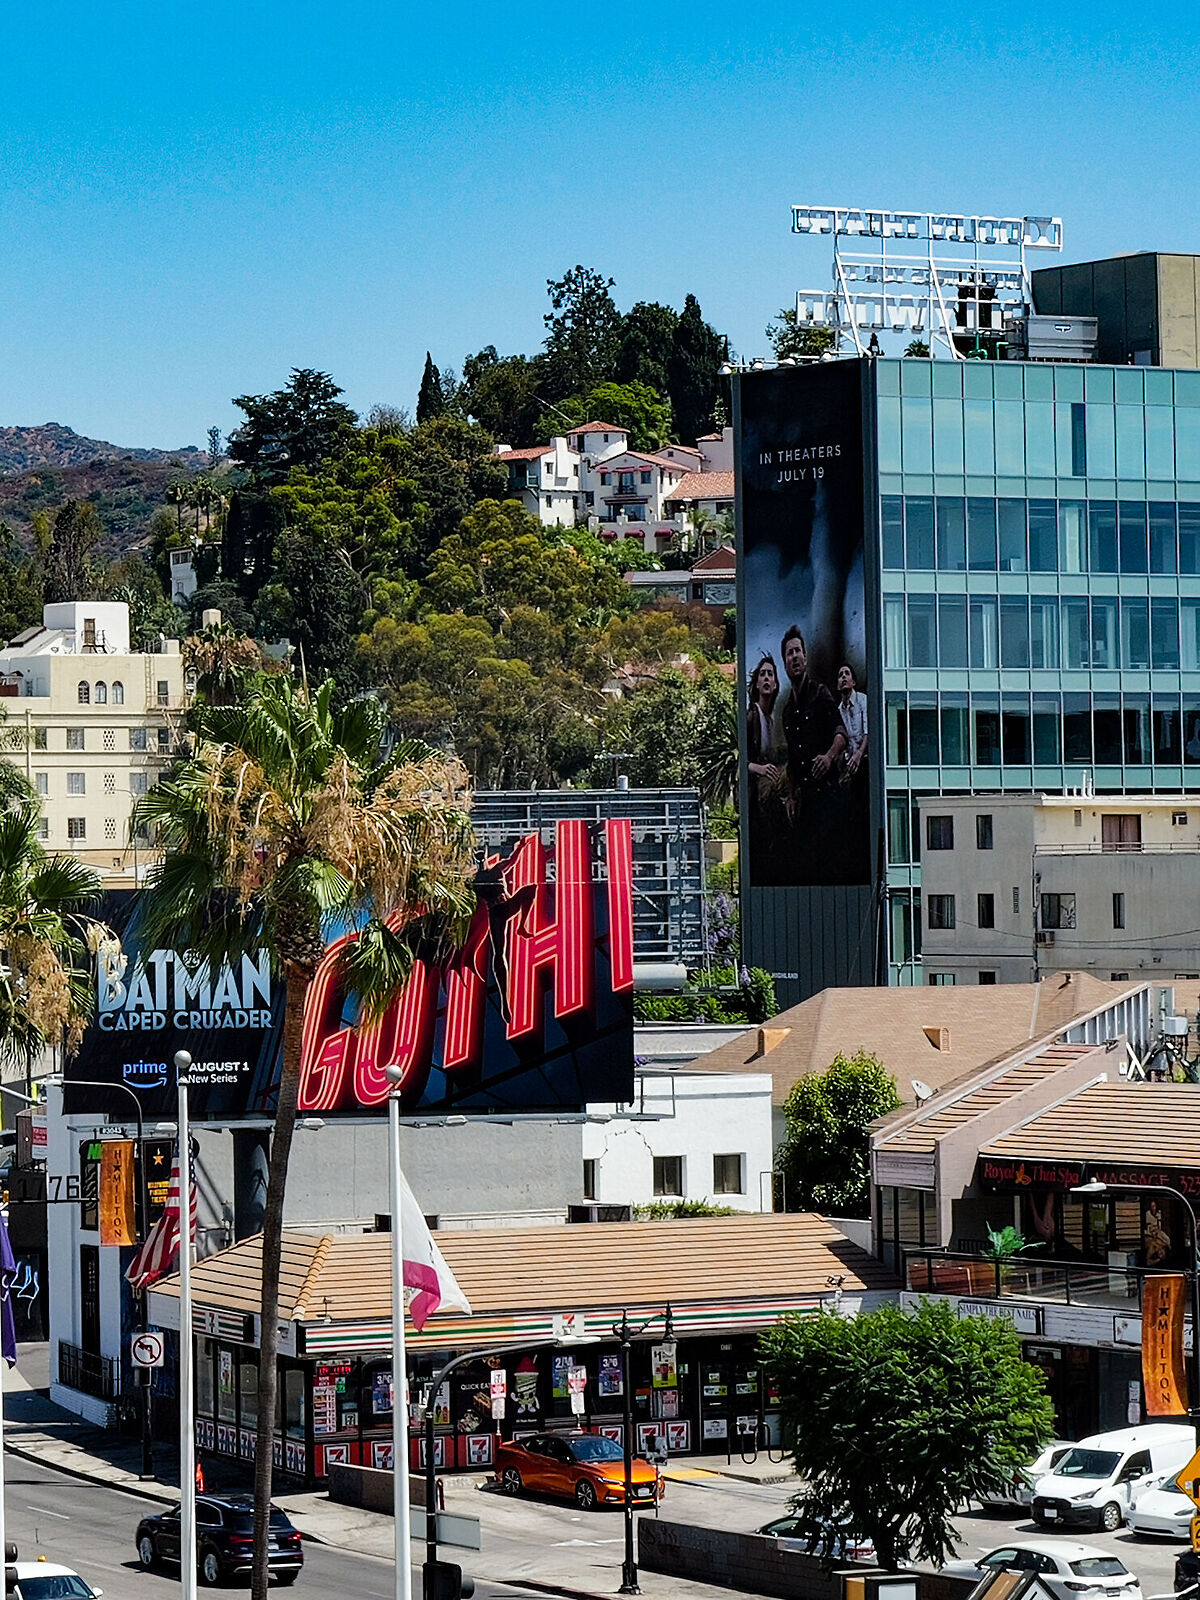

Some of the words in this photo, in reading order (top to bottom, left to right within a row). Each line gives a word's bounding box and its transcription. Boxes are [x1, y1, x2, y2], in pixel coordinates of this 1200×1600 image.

[759, 452, 772, 465] IN
[777, 444, 842, 463] THEATERS
[777, 468, 807, 483] JULY
[812, 466, 825, 480] 19
[98, 948, 271, 1013] BATMAN
[98, 1010, 167, 1031] CAPED
[172, 1008, 273, 1030] CRUSADER
[122, 1059, 168, 1077] prime
[188, 1062, 240, 1073] AUGUST
[241, 1061, 250, 1072] 1
[187, 1074, 209, 1085] New
[211, 1074, 238, 1084] Series
[984, 1162, 1015, 1184] Royal
[1030, 1164, 1057, 1183] Thai
[1057, 1166, 1080, 1188] Spa
[959, 1303, 983, 1316] SIMPLY
[985, 1305, 998, 1317] THE
[1016, 1308, 1037, 1321] NAILS
[460, 1383, 479, 1391] QUICK
